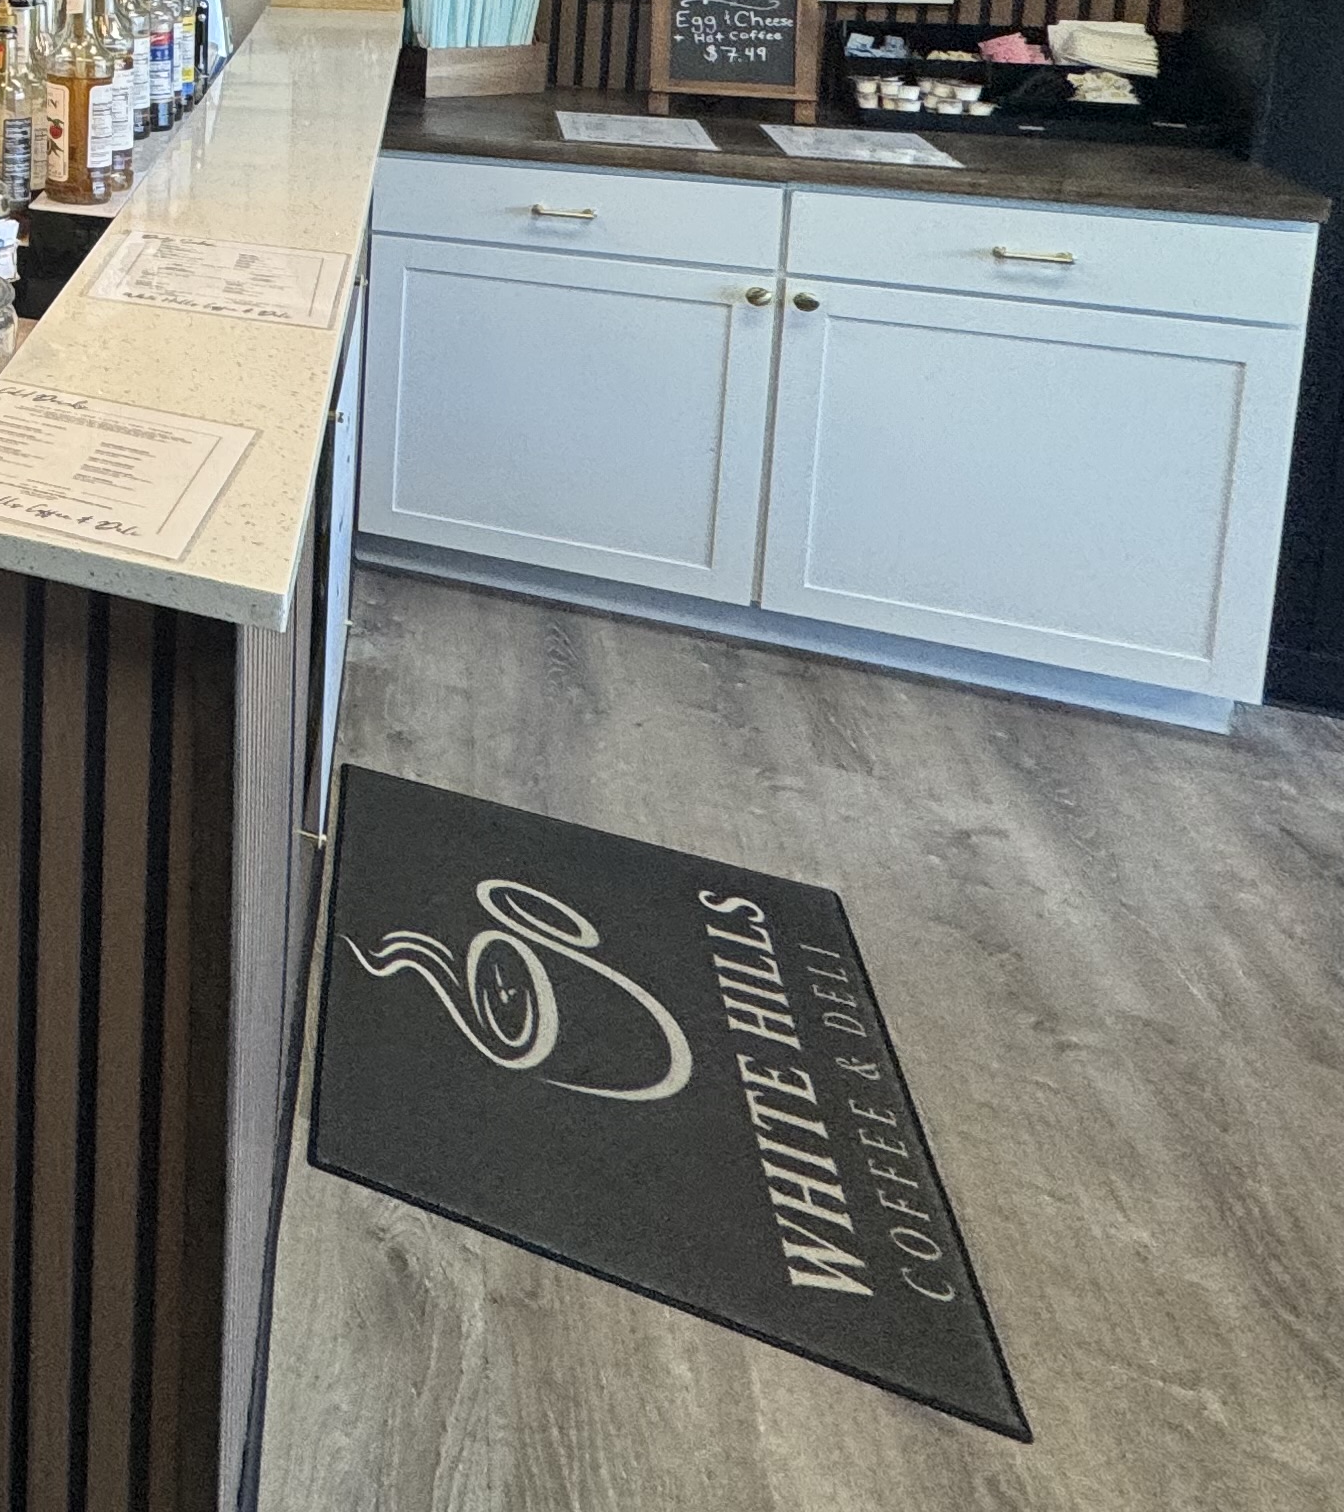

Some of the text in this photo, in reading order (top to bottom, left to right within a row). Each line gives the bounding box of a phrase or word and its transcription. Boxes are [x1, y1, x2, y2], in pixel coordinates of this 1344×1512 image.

[676, 11, 717, 33] Egg
[734, 11, 793, 27] Cheese
[694, 32, 725, 43] Hot
[703, 45, 767, 62] $7.49
[698, 890, 874, 1296] WHITE HILLS
[800, 944, 955, 1301] COFFEE & DELI
